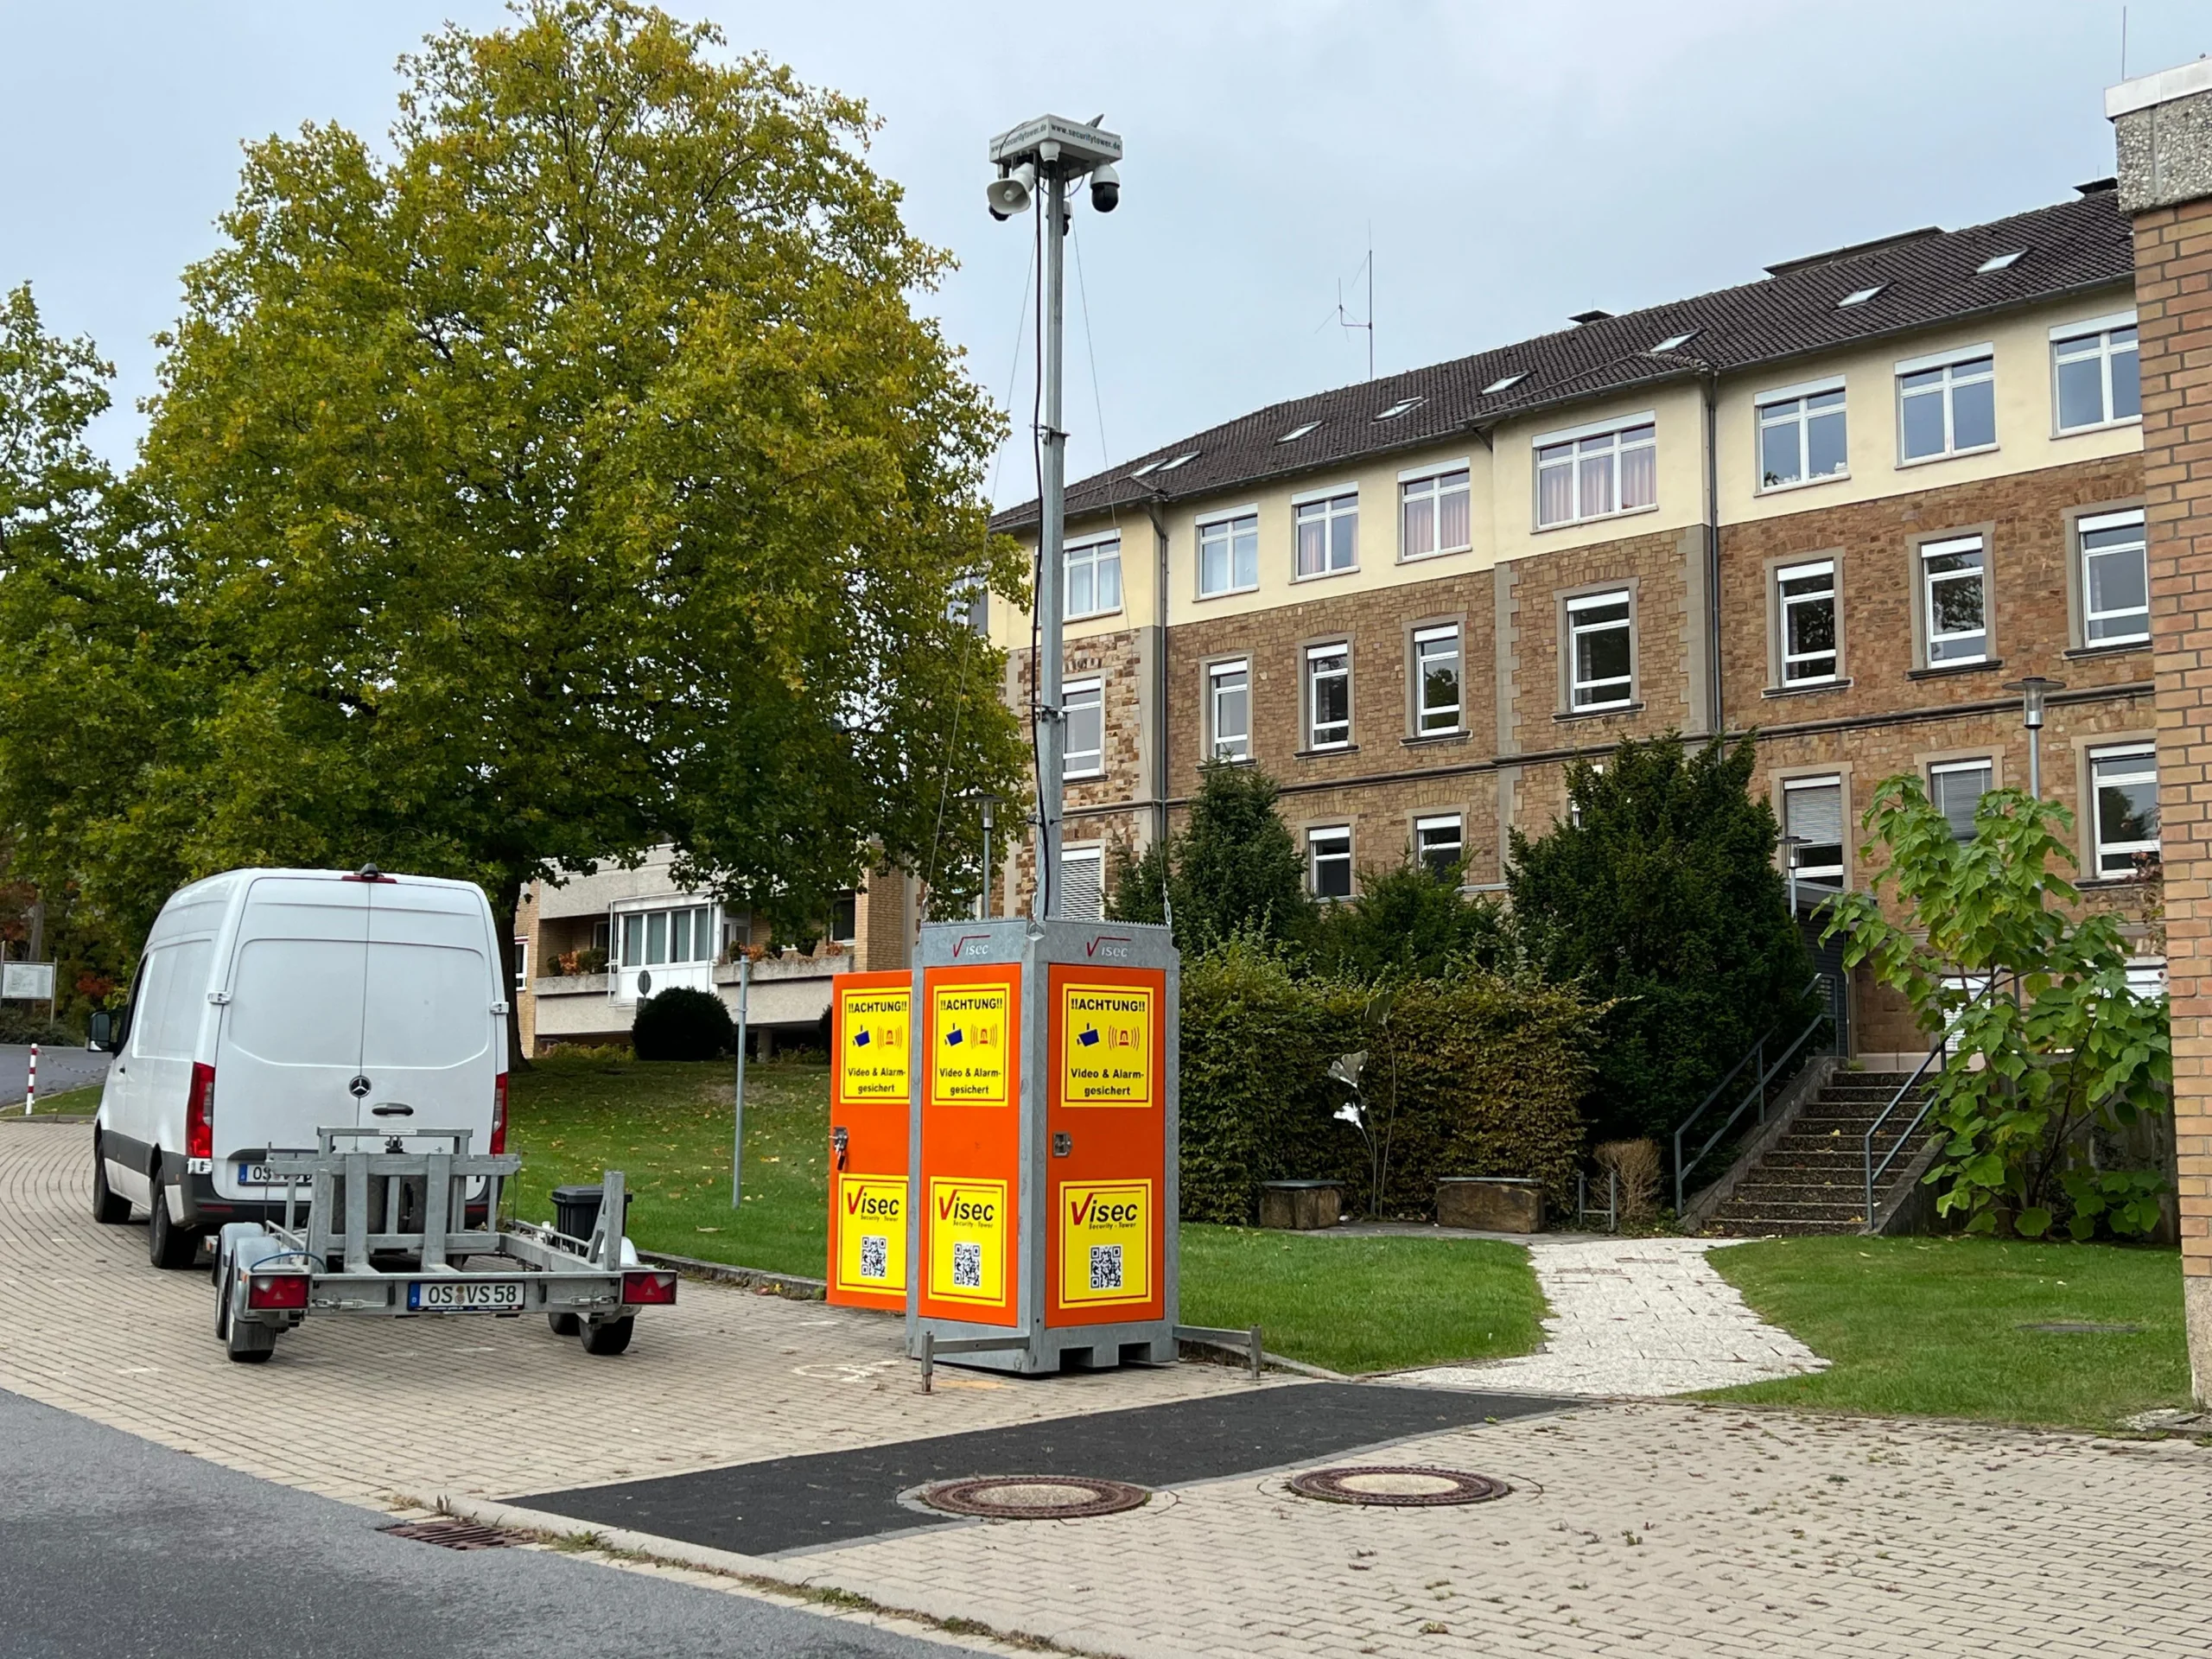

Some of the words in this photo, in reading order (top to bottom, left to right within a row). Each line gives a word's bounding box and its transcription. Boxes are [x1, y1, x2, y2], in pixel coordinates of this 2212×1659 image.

[990, 124, 1047, 153] wwsecuritytower.de
[1051, 123, 1121, 151] www.securitytower.de
[849, 1001, 907, 1014] !!ACHTUNG!!
[940, 997, 1003, 1011] !!ACHTUNG!!
[1071, 998, 1146, 1012] !!ACHTUNG!!
[848, 1067, 870, 1077] Video
[872, 1067, 878, 1077] &
[880, 1067, 906, 1077] Alarm-
[939, 1067, 963, 1077] Video
[965, 1068, 971, 1077] &
[974, 1068, 1001, 1077] Alarm-
[1071, 1068, 1099, 1078] Video
[1102, 1068, 1109, 1078] &
[1112, 1069, 1145, 1078] Alarm-
[857, 1083, 895, 1095] gesichert
[950, 1084, 989, 1096] gesichert
[1084, 1086, 1131, 1097] gesichert
[847, 1185, 900, 1216] Visec
[938, 1189, 995, 1222] Visec
[1071, 1192, 1139, 1225] Visec
[428, 1285, 454, 1304] OS
[467, 1285, 490, 1304] VS
[493, 1285, 517, 1303] 58
